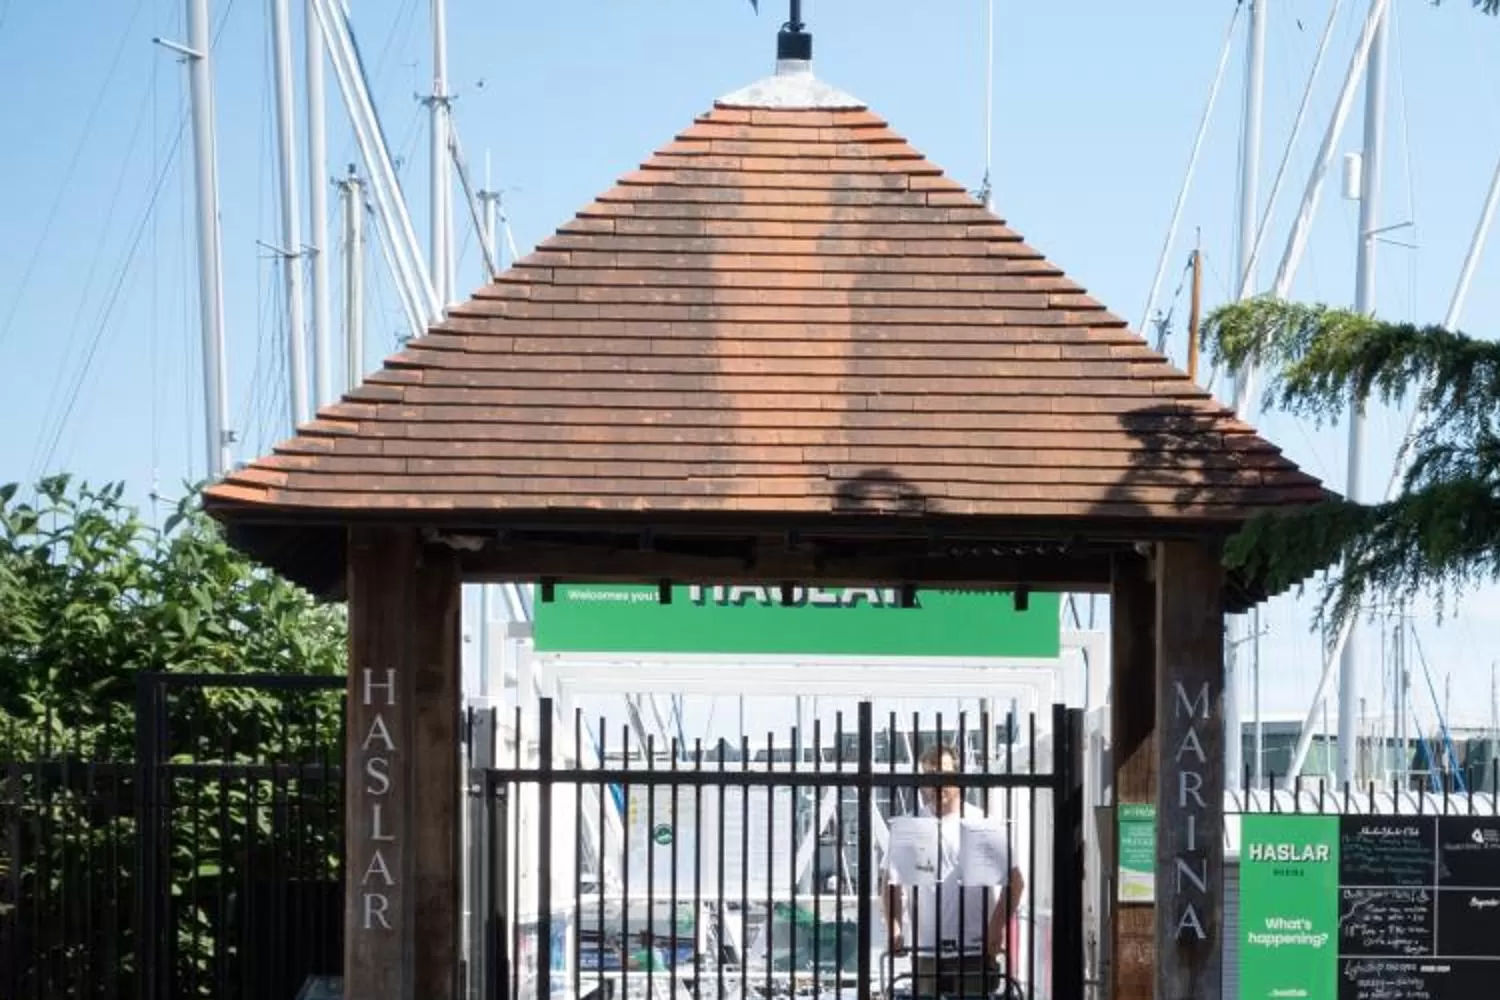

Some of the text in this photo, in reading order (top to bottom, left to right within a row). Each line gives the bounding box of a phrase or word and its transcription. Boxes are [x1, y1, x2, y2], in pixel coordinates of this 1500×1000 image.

[568, 589, 629, 601] Welcomes
[631, 592, 652, 604] you
[362, 668, 397, 929] HASLAR
[1174, 681, 1210, 939] MARINA
[1249, 843, 1330, 861] HASLAR
[1265, 917, 1312, 929] What's
[1248, 932, 1329, 948] happening?
